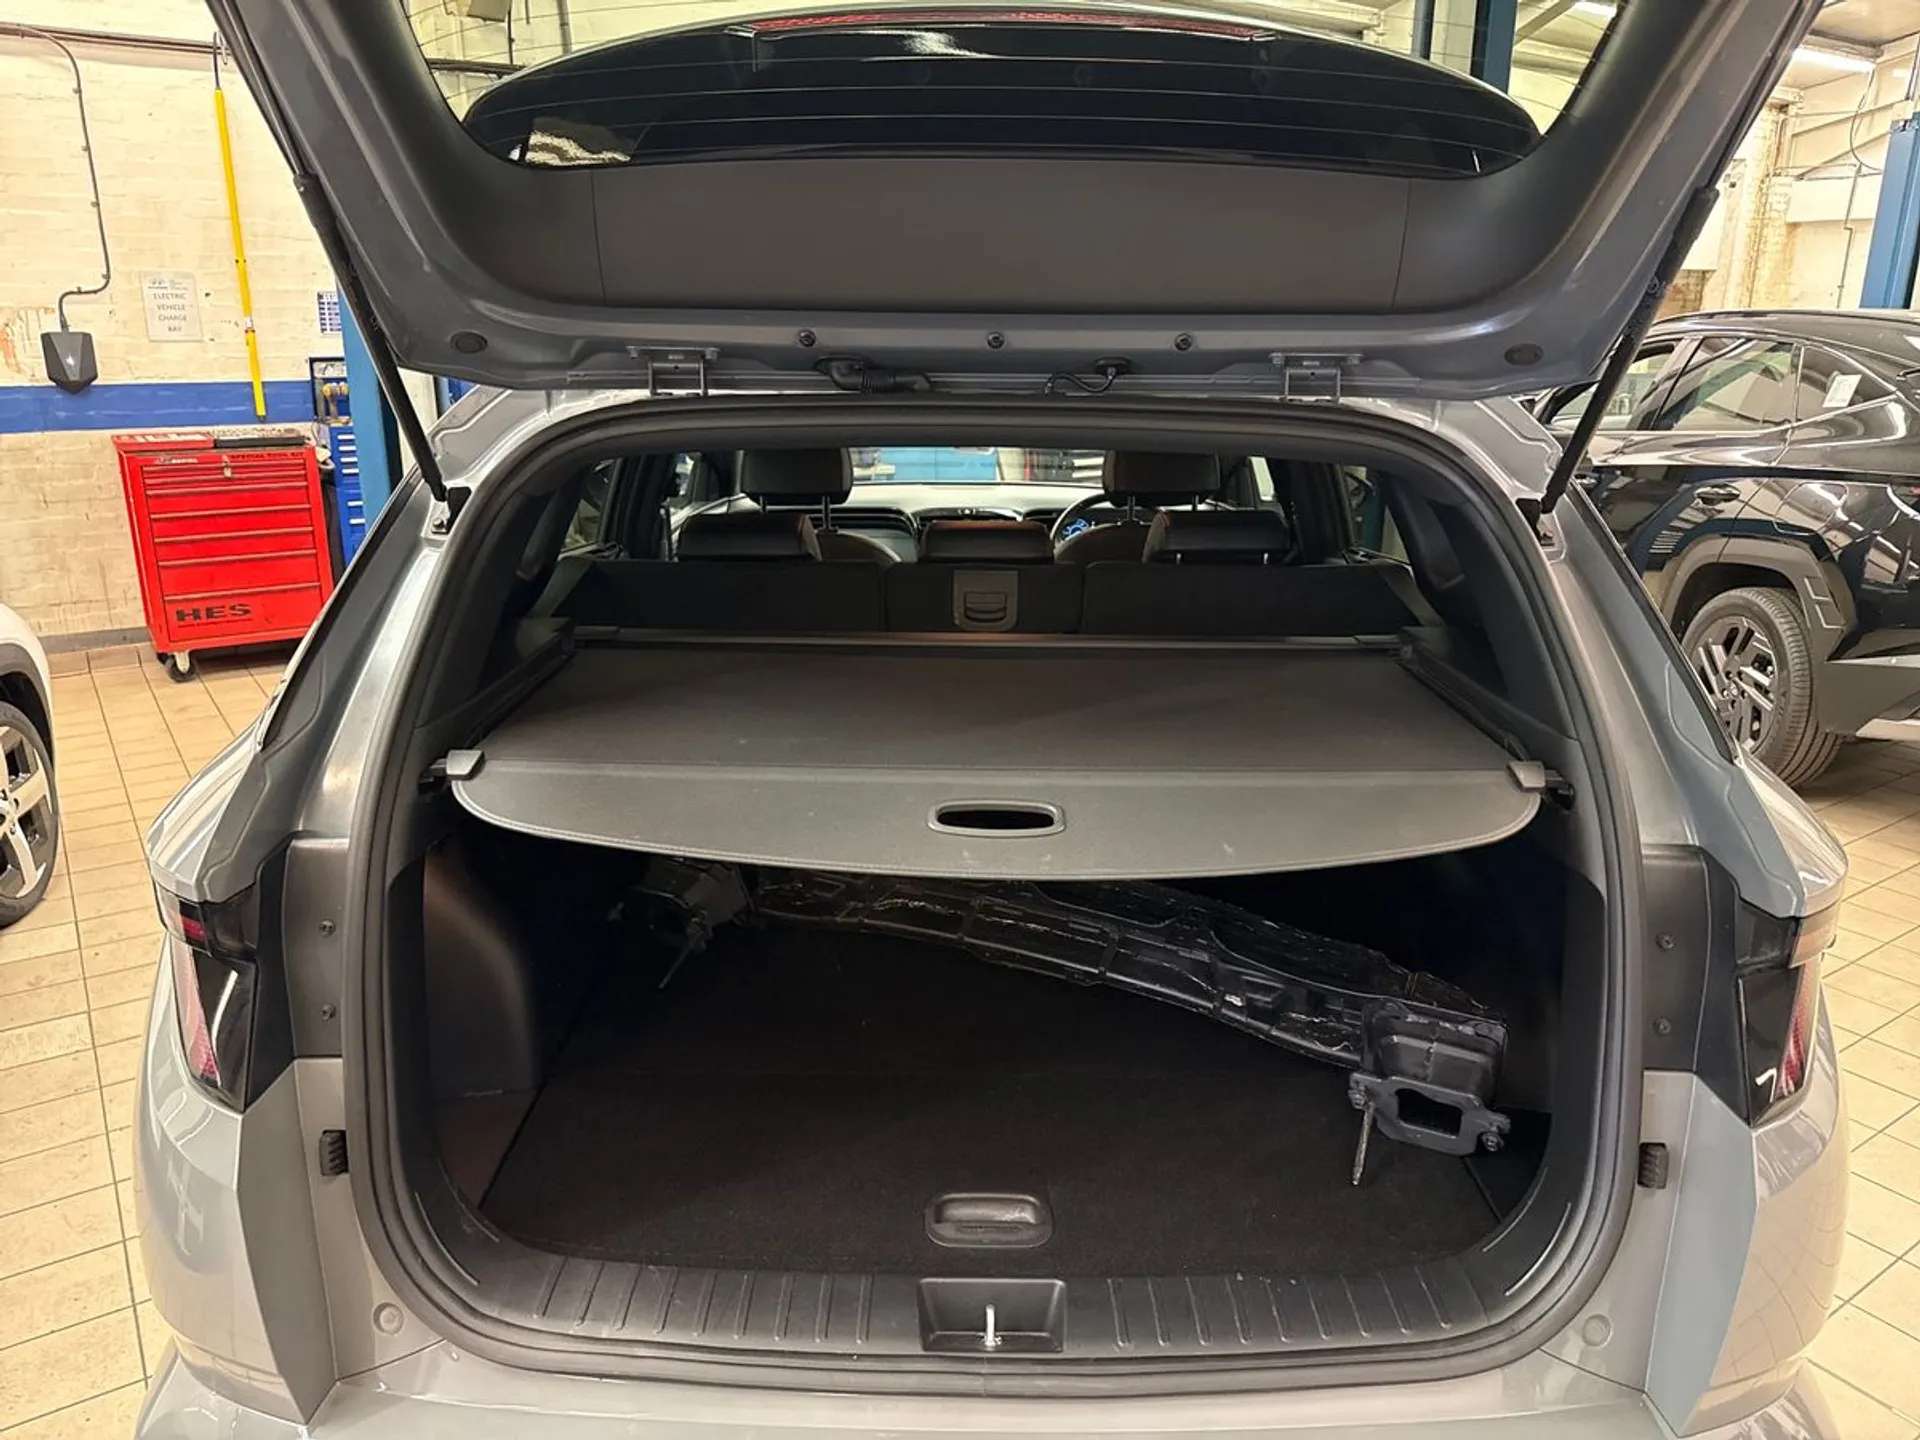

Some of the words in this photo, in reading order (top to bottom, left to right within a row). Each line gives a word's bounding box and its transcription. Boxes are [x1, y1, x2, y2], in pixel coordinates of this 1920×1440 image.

[153, 292, 187, 300] ELECTRIC
[156, 303, 186, 311] VEHICLE
[158, 313, 187, 321] CHARGE
[175, 603, 251, 621] HES
